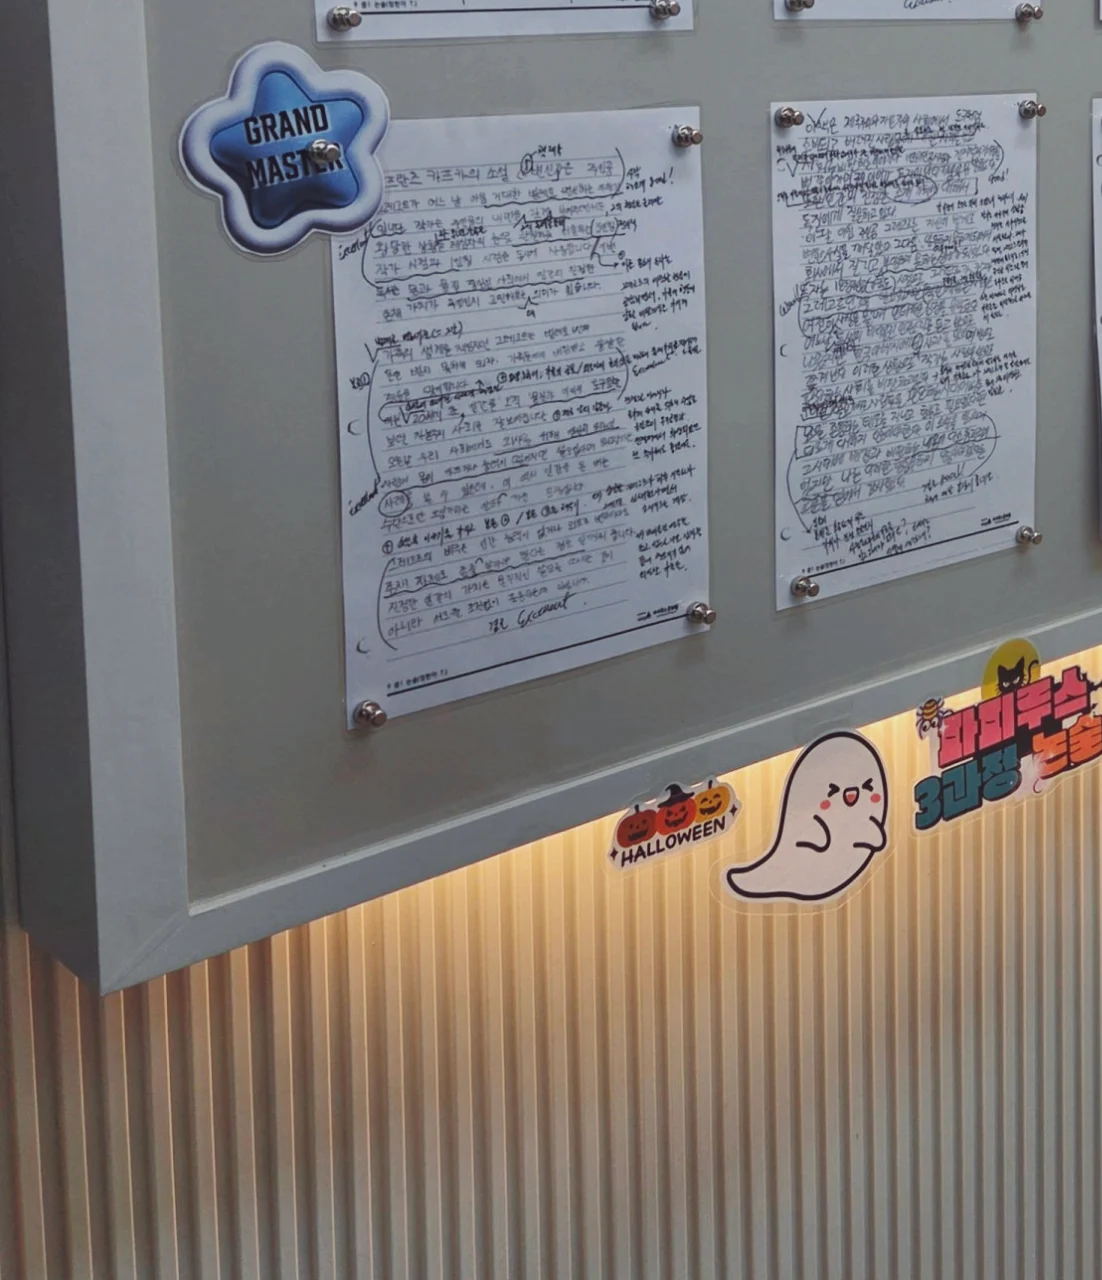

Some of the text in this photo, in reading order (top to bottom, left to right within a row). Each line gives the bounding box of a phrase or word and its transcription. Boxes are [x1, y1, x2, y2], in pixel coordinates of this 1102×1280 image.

[243, 104, 330, 145] GRAND
[245, 143, 344, 188] MASTR
[936, 665, 1094, 768] 파피루스
[915, 745, 1022, 830] 3과정
[621, 816, 726, 868] HALLOWEEN
